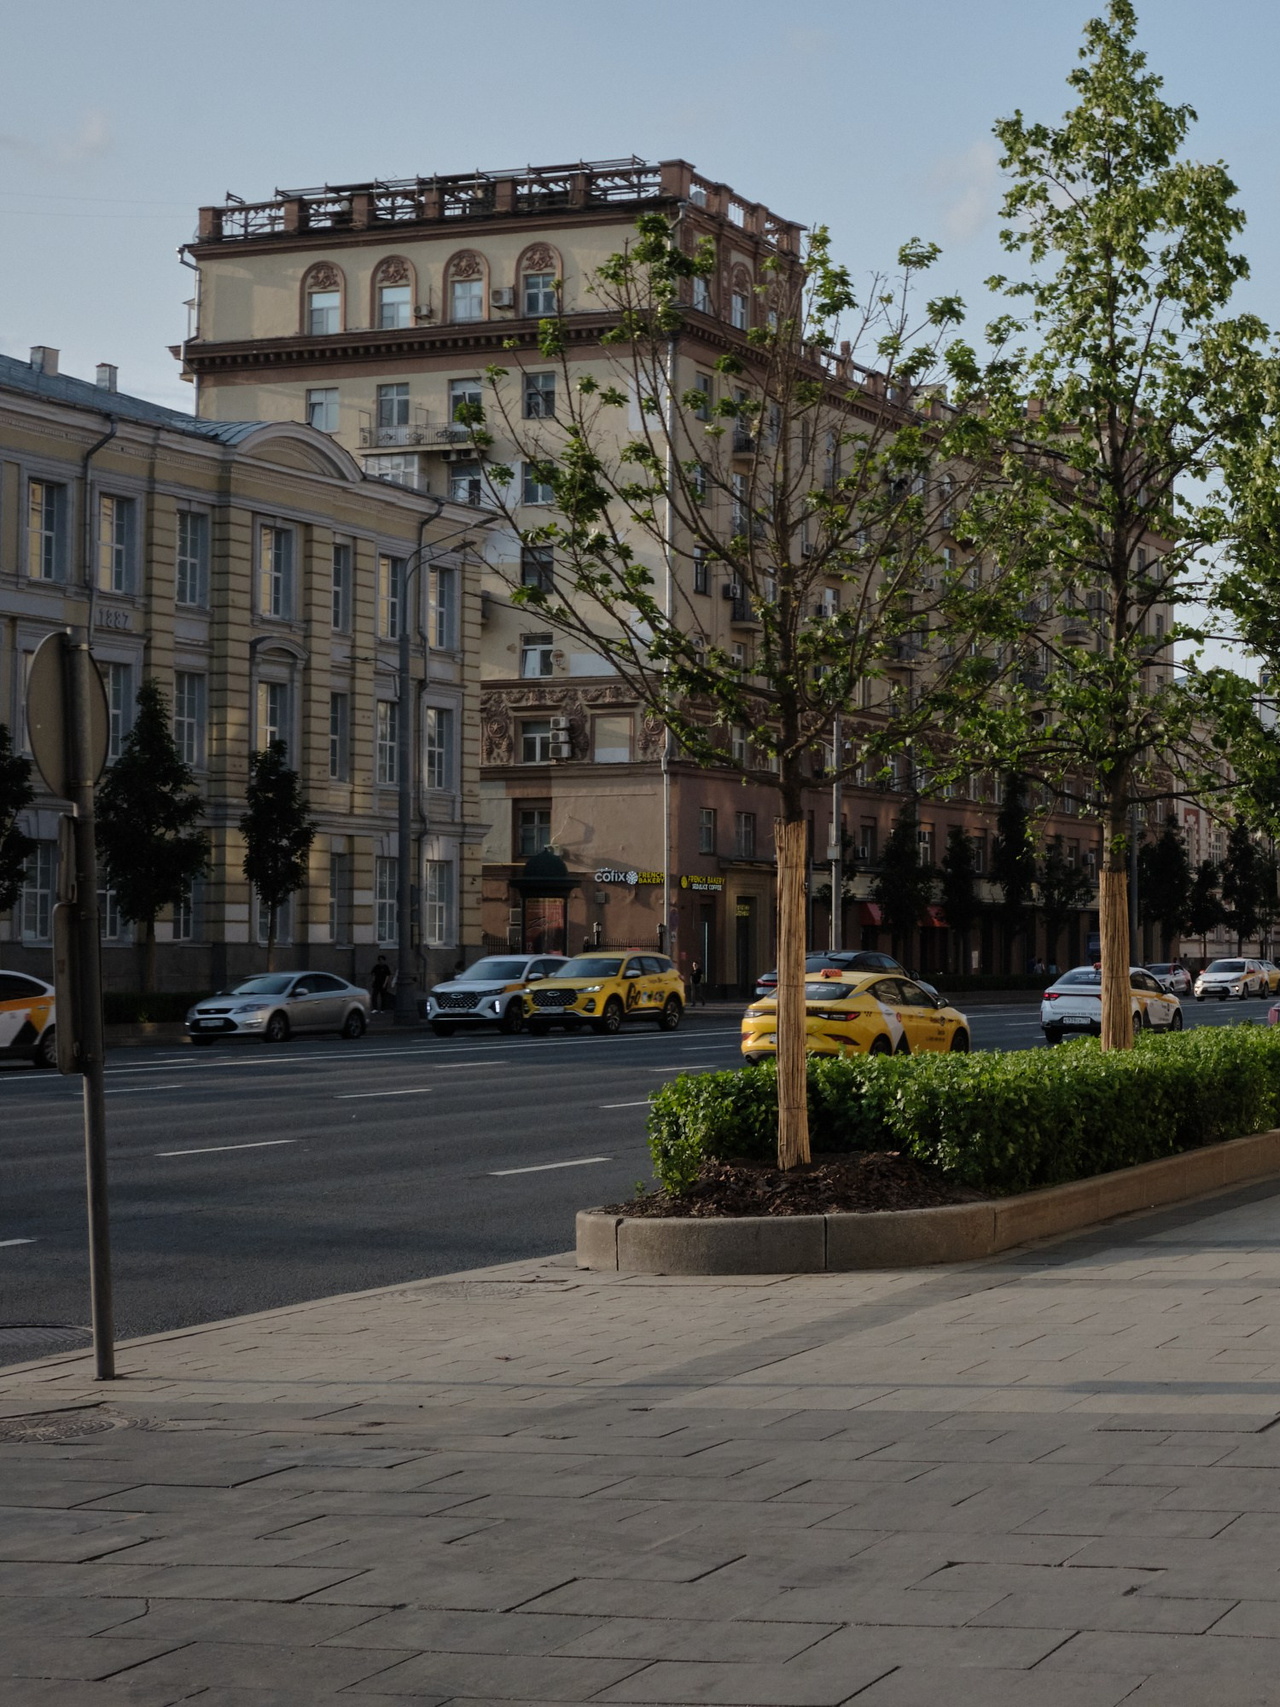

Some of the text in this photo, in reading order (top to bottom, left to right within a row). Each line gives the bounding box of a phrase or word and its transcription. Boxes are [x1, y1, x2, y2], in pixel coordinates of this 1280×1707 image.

[99, 608, 129, 630] 1887
[595, 870, 626, 883] cofix
[688, 875, 725, 885] FRENCH BAKERY
